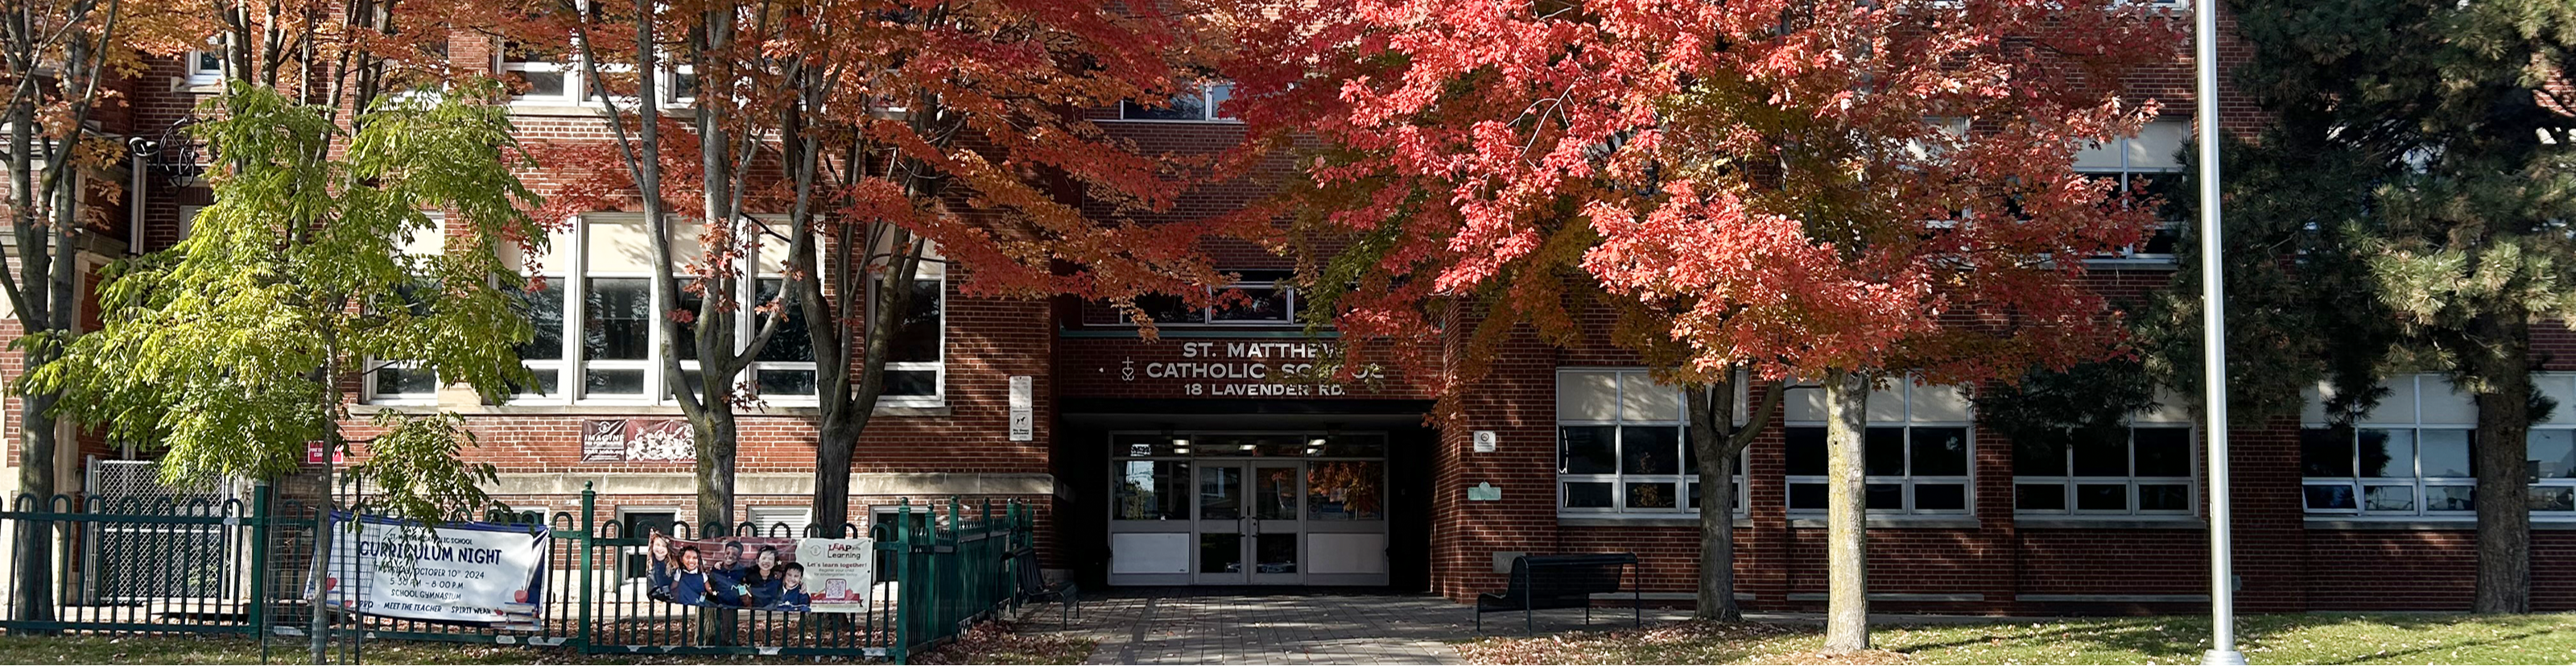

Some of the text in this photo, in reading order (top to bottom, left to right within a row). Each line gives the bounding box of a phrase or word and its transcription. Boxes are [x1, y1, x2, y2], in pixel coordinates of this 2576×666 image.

[1183, 342, 1216, 358] ST.
[1146, 362, 1265, 379] CATHOLIC
[1184, 383, 1346, 396] 18 LAVENDER RD.
[828, 543, 852, 552] LEAP
[458, 548, 502, 565] NIGHT
[828, 551, 861, 560] Learning
[414, 567, 445, 577] OCTOBER
[464, 570, 485, 579] 2024
[390, 589, 461, 600] SCHOOL GYMNASIUM
[384, 602, 400, 610] MEET
[402, 603, 413, 611] THE
[414, 603, 442, 613] TEACHER
[451, 606, 472, 614] SPIRIT
